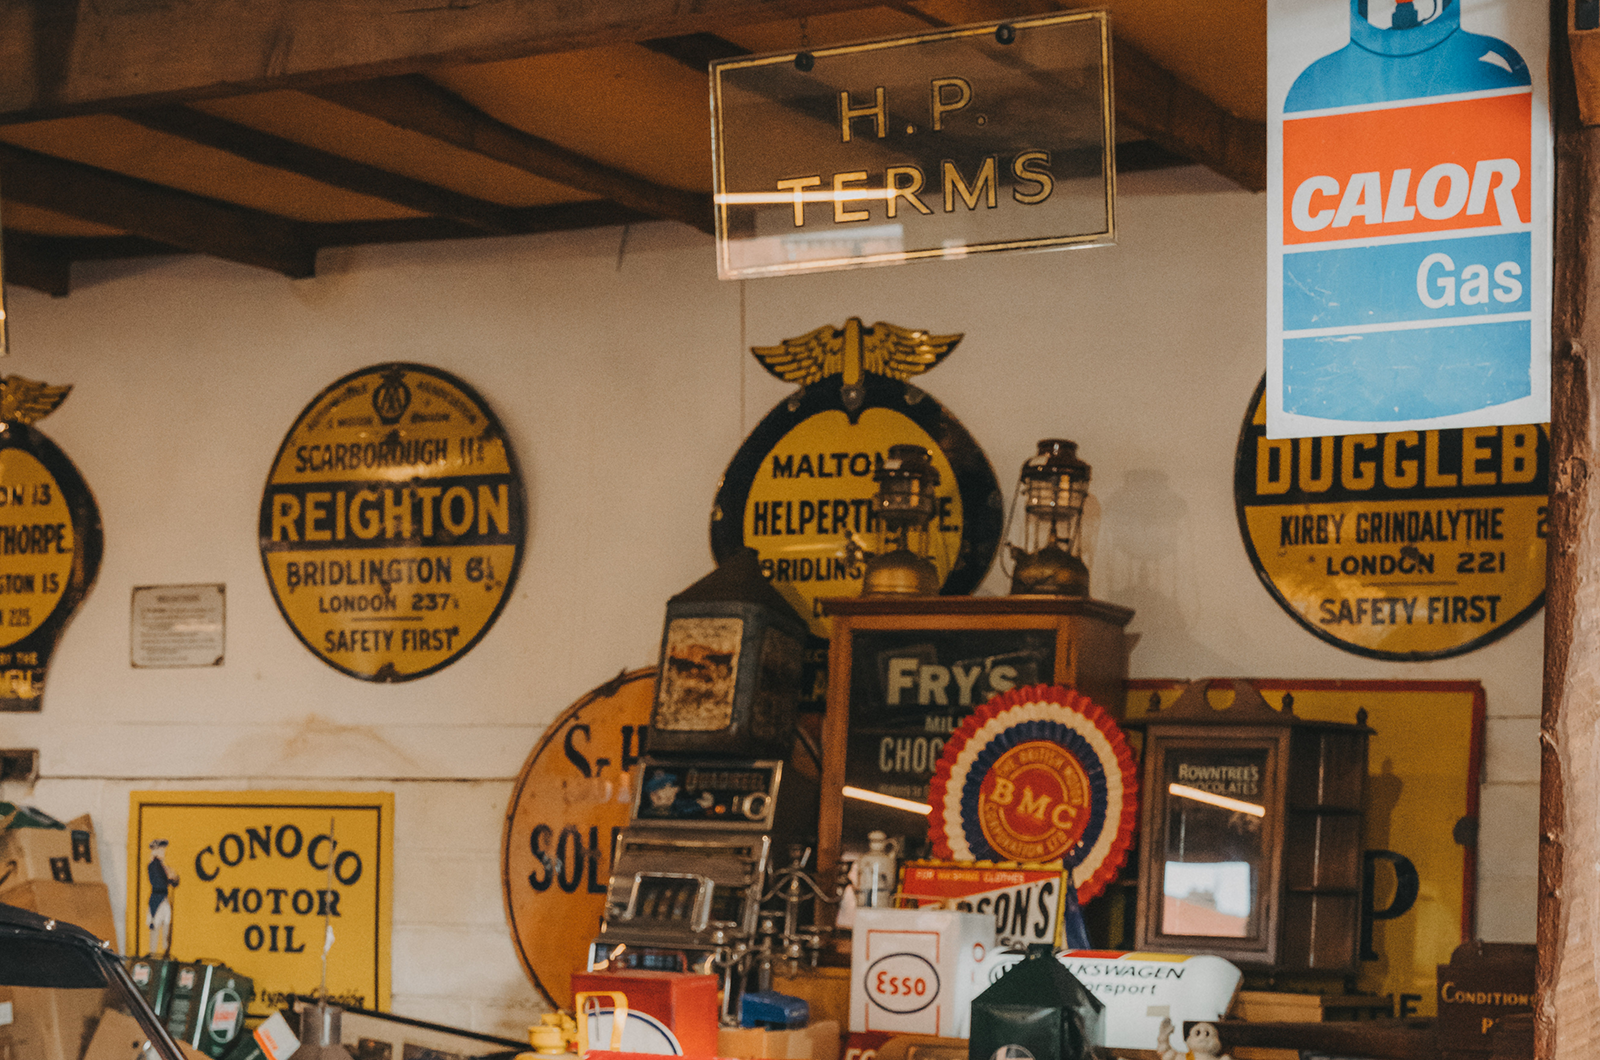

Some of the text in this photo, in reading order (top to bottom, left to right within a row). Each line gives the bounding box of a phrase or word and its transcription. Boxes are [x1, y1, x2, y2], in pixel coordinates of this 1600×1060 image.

[776, 149, 1056, 228] TERMS
[1291, 158, 1522, 232] CALOR
[1416, 253, 1523, 309] Gas
[1255, 423, 1549, 495] DUGGLEB
[271, 484, 510, 542] REIGHTON
[1279, 513, 1345, 546] KIRBY
[1355, 508, 1505, 544] GRINDALYTHE
[286, 557, 452, 586] BRIDLINGTON
[1326, 551, 1506, 576] LONDON 221
[319, 593, 398, 613] LONDON
[1319, 595, 1501, 625] SAFETY FIRST
[323, 627, 454, 653] SAFETY FIRST
[887, 656, 1018, 706] FRY'S
[194, 824, 363, 886] CONOCO
[215, 887, 341, 917] MOTOR
[243, 925, 305, 953] OIL
[876, 971, 926, 996] ESSO
